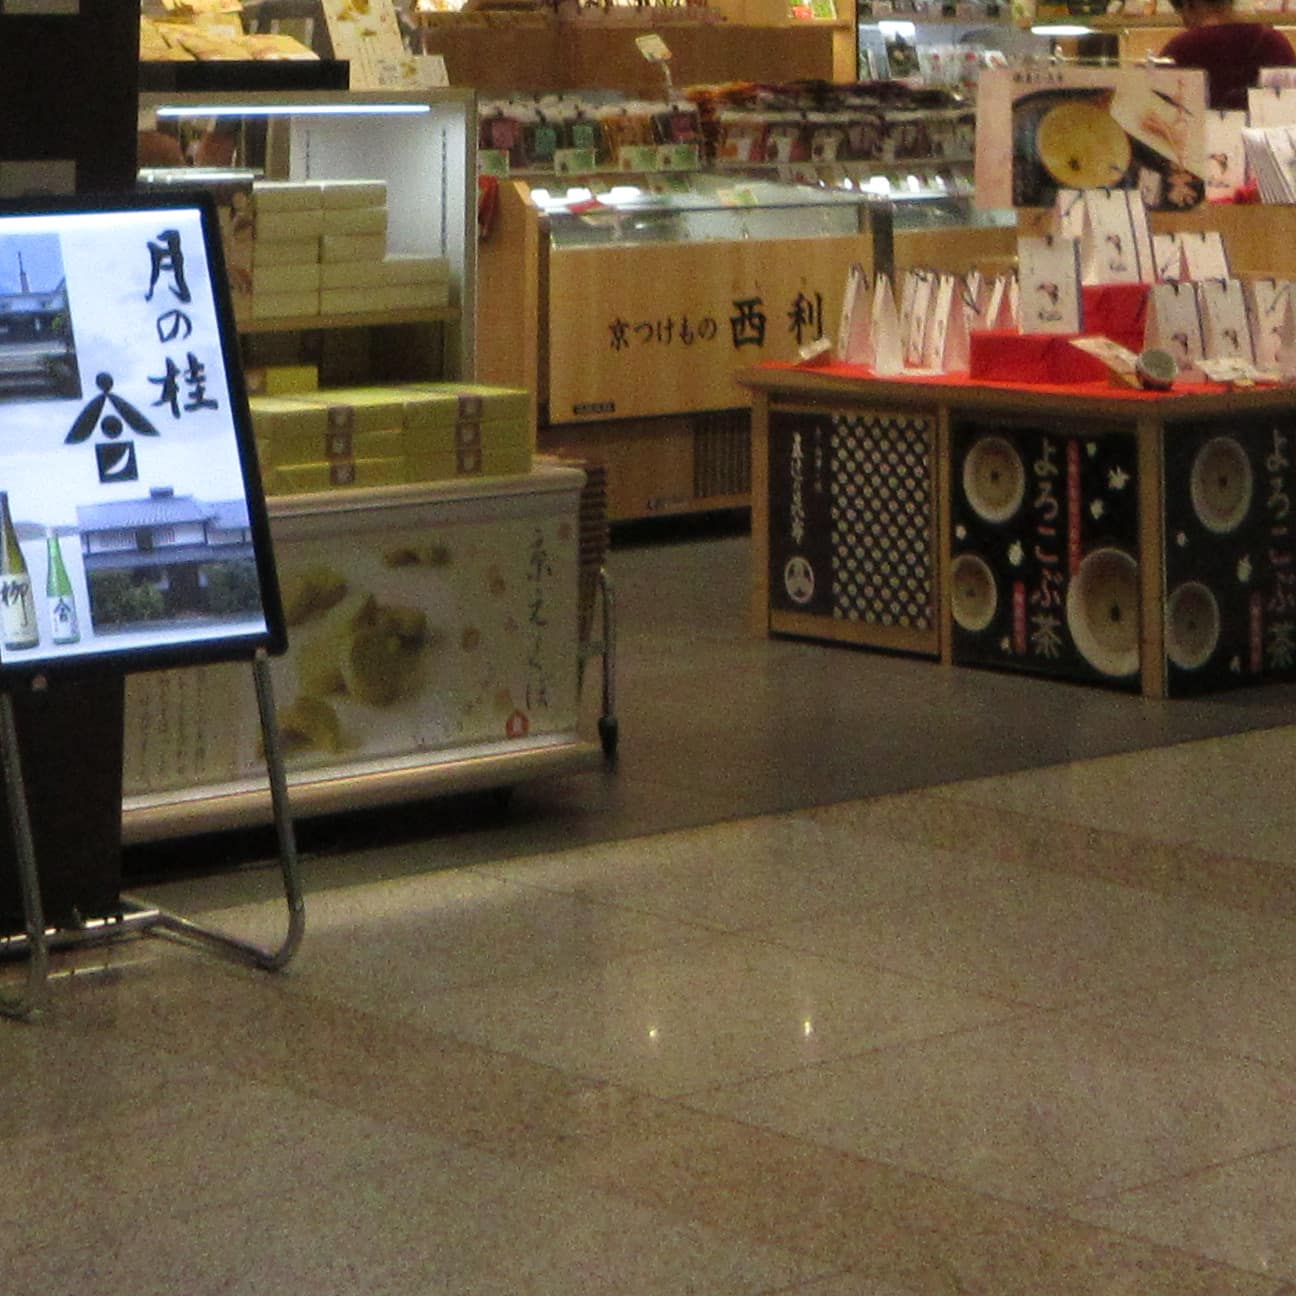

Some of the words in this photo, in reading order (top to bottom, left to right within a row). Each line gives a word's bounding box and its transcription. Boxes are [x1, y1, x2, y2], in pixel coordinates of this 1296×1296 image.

[144, 229, 218, 419] 月の桂
[609, 316, 717, 352] 京つけもの
[731, 290, 825, 349] 西利
